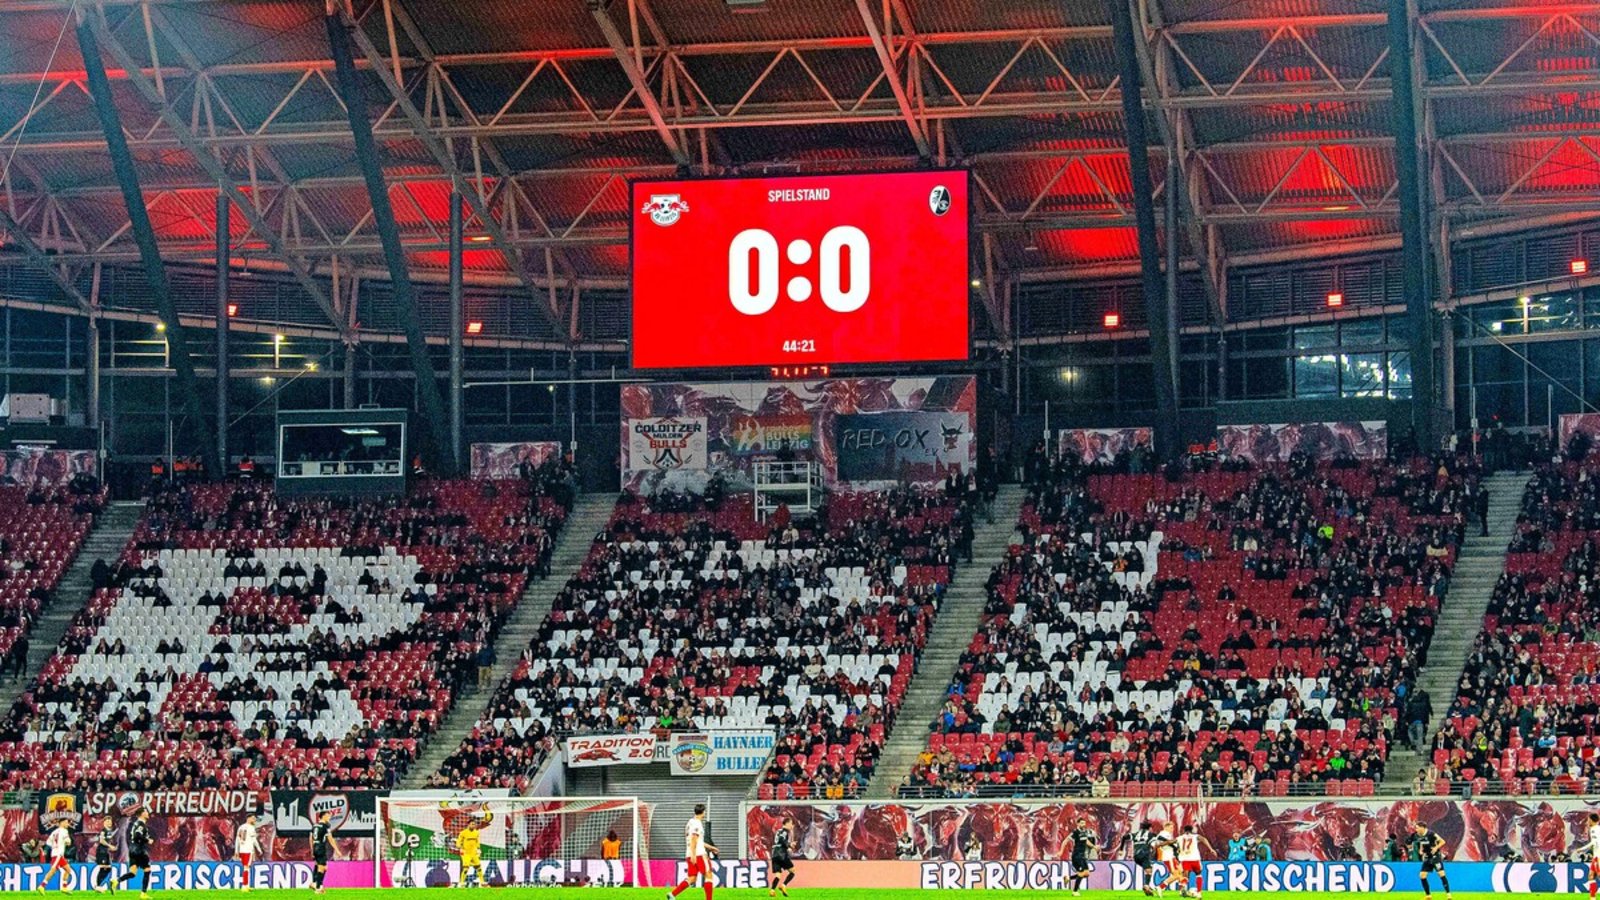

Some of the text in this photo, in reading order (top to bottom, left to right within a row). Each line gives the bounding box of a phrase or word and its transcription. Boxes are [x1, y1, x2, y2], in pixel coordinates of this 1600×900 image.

[768, 188, 830, 202] SPIELSTAND
[729, 225, 870, 315] 0:0
[782, 339, 816, 353] 44:21
[635, 421, 702, 433] COLDITZER
[767, 431, 800, 441] BULLS
[842, 428, 930, 449] RED OX
[650, 440, 687, 449] BULLS
[571, 738, 654, 750] TRADITION
[714, 736, 773, 749] HAYNAER
[629, 748, 653, 758] 2.0
[313, 799, 345, 811] WILD
[1205, 862, 1395, 892] FRISCHEND
